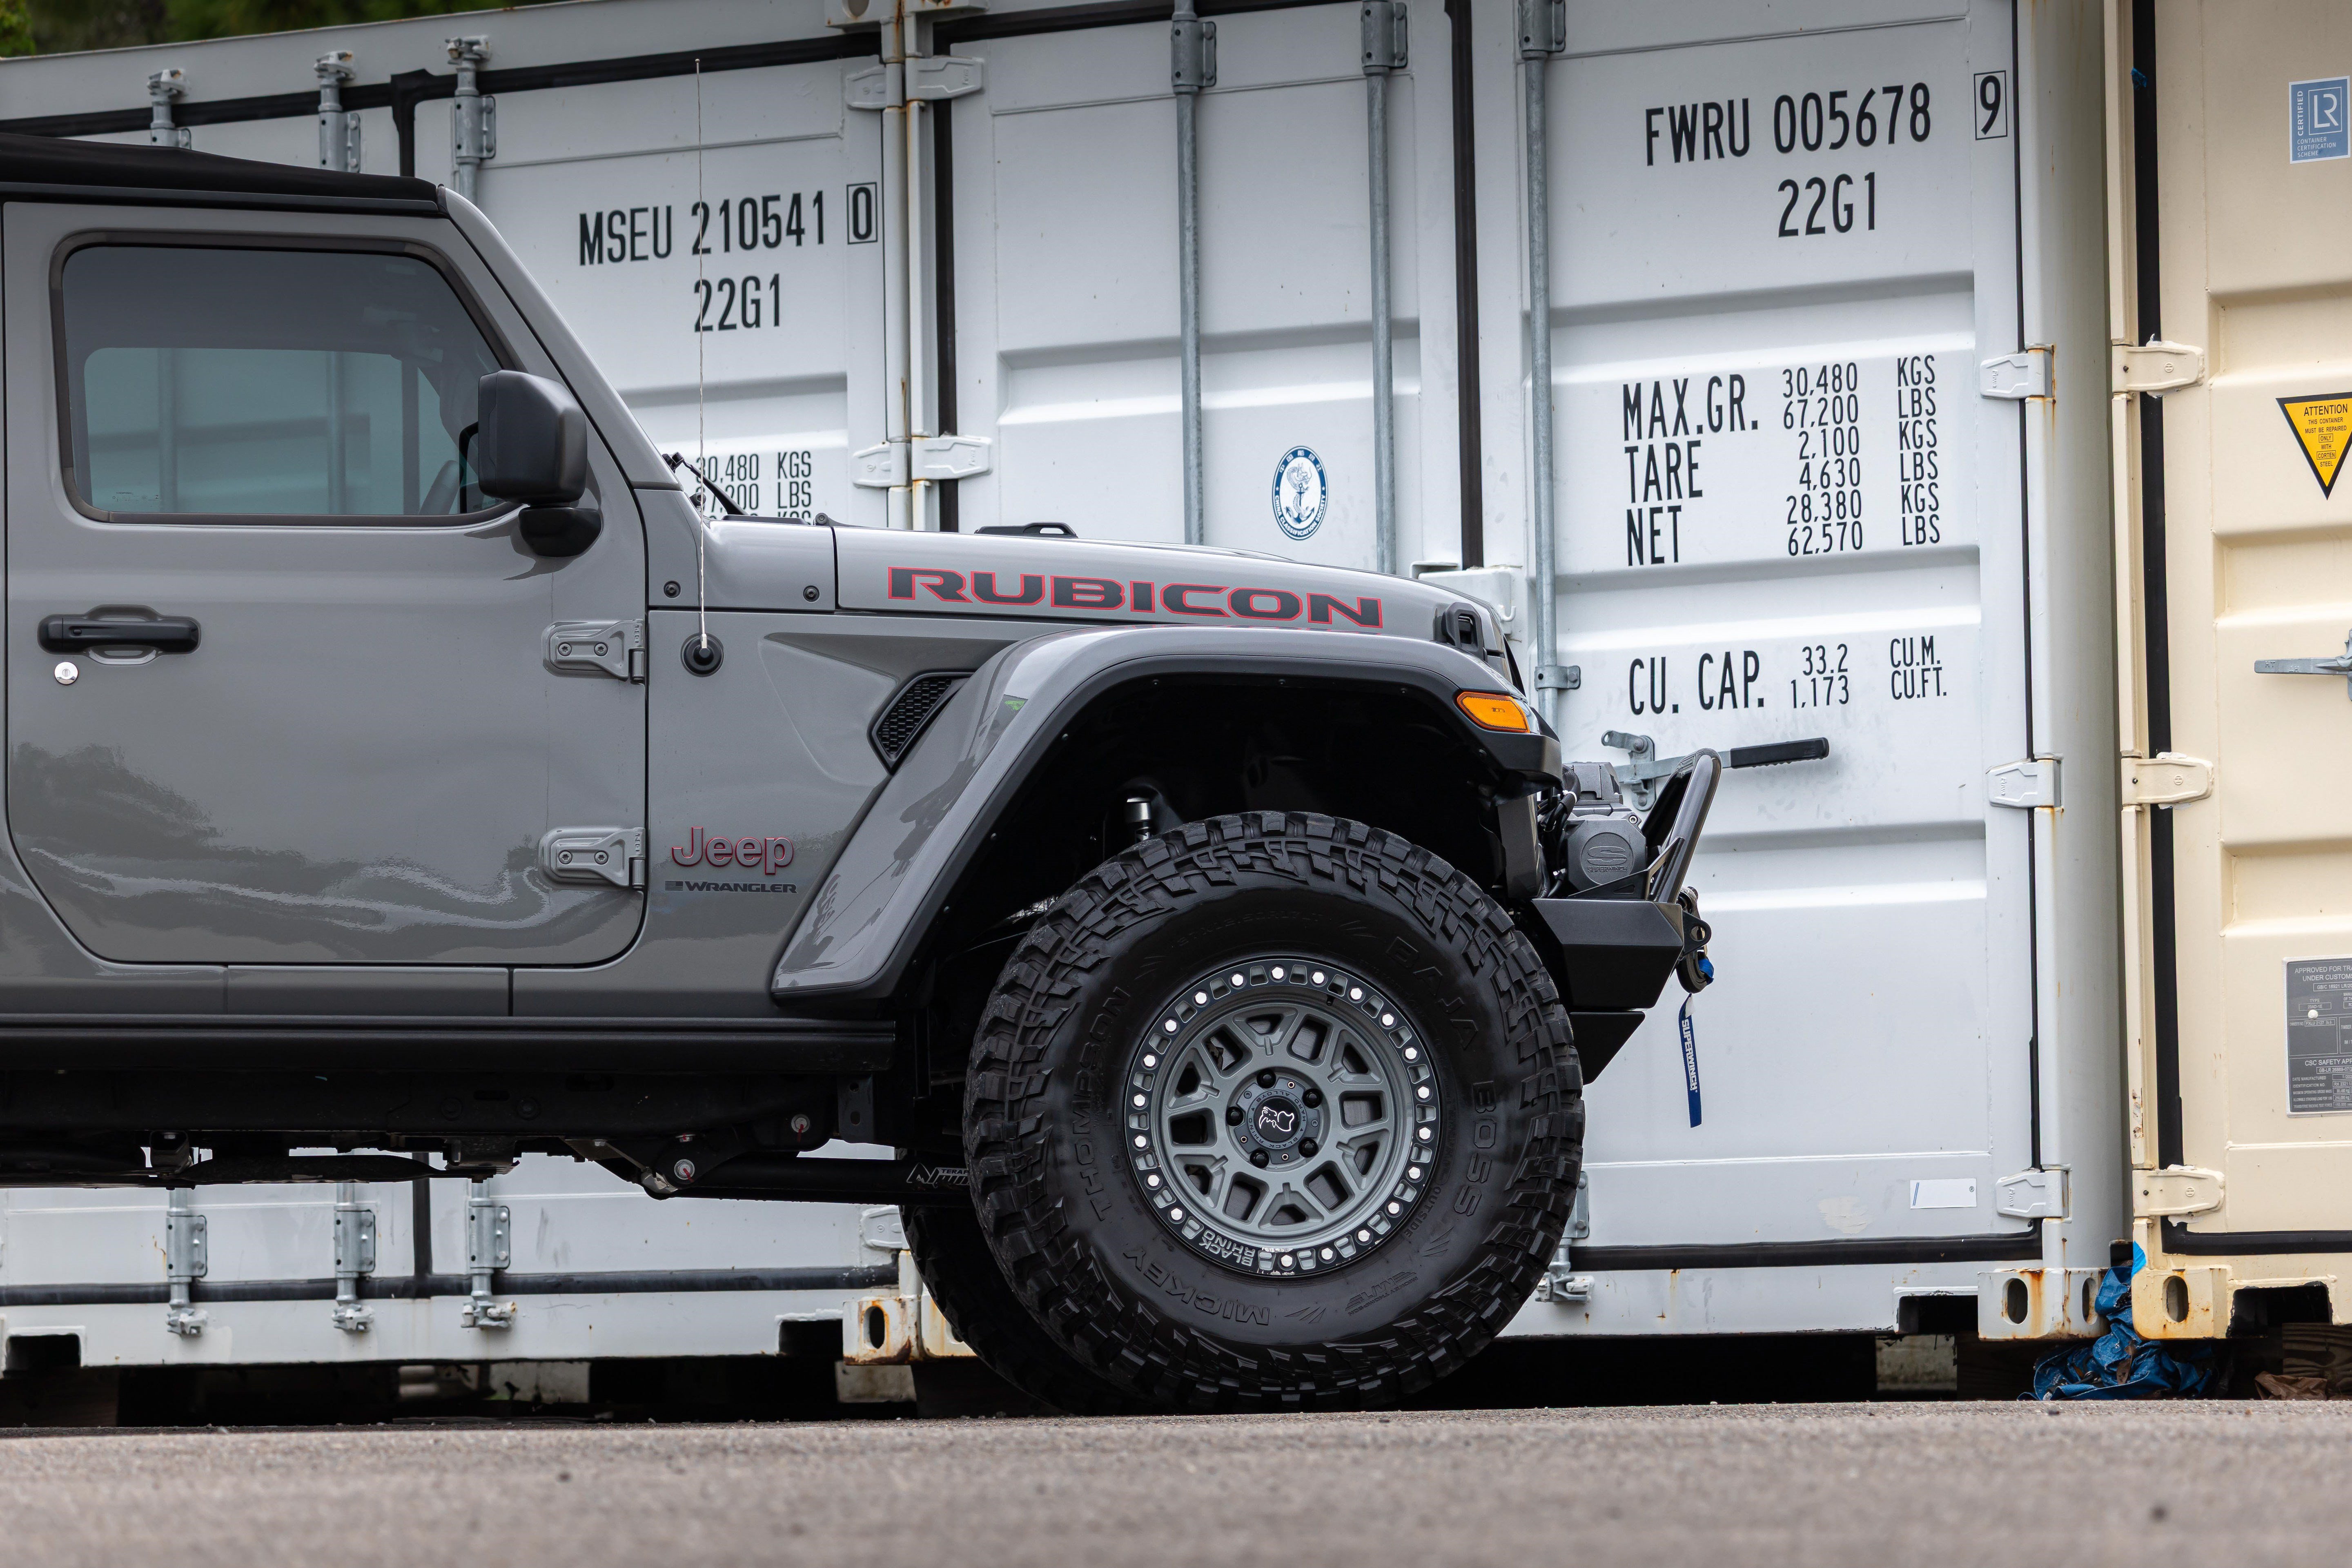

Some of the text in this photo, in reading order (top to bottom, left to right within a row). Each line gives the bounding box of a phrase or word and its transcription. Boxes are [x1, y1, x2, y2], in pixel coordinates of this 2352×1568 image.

[1646, 74, 2002, 166] FWRU 005678 9
[2314, 94, 2339, 128] LR
[2297, 142, 2336, 151] CERTIFICATION
[580, 186, 873, 266] MSEU 210541 0
[1778, 172, 1875, 238] 22G1
[694, 273, 780, 332] 22G1
[1623, 355, 1936, 441] MAX.GR. 30,480 KGS
[1783, 387, 1936, 430] 67,200 LBS
[2304, 404, 2348, 416] ATTENTION
[777, 450, 811, 479] KGS
[1624, 419, 1938, 504] TARE 2,100 KGS
[1799, 450, 1938, 491] 4,630 LBS
[777, 480, 811, 510] LBS
[1279, 517, 1317, 536] CLASSIFICATION
[1315, 495, 1325, 522] SOCIETY
[1626, 483, 1939, 566] NET 28,380 KGS
[1787, 514, 1940, 556] 62,570 LBS
[888, 566, 1383, 629] RUBICON
[1629, 635, 1941, 715] CU. CAP. 33.2 CU.M.
[1790, 666, 1947, 709] 1,173 CU.FT.
[672, 826, 794, 875] Jeep
[684, 880, 798, 893] WRANGLER
[1385, 936, 1479, 1051] BAJA
[1682, 1018, 1698, 1091] SUPERWINCH
[1072, 986, 1130, 1221] THOMPSON
[1256, 1091, 1290, 1102] ALLOYS
[1294, 1098, 1306, 1122] HARD
[1248, 1118, 1264, 1144] RHINO
[1269, 1137, 1298, 1148] BLACK
[1453, 1080, 1497, 1216] BOSS
[1403, 1186, 1441, 1239] OUTSIDE
[1199, 1236, 1253, 1266] BLACK
[1203, 1229, 1255, 1257] RHINO
[1123, 1249, 1270, 1326] MICKEY
